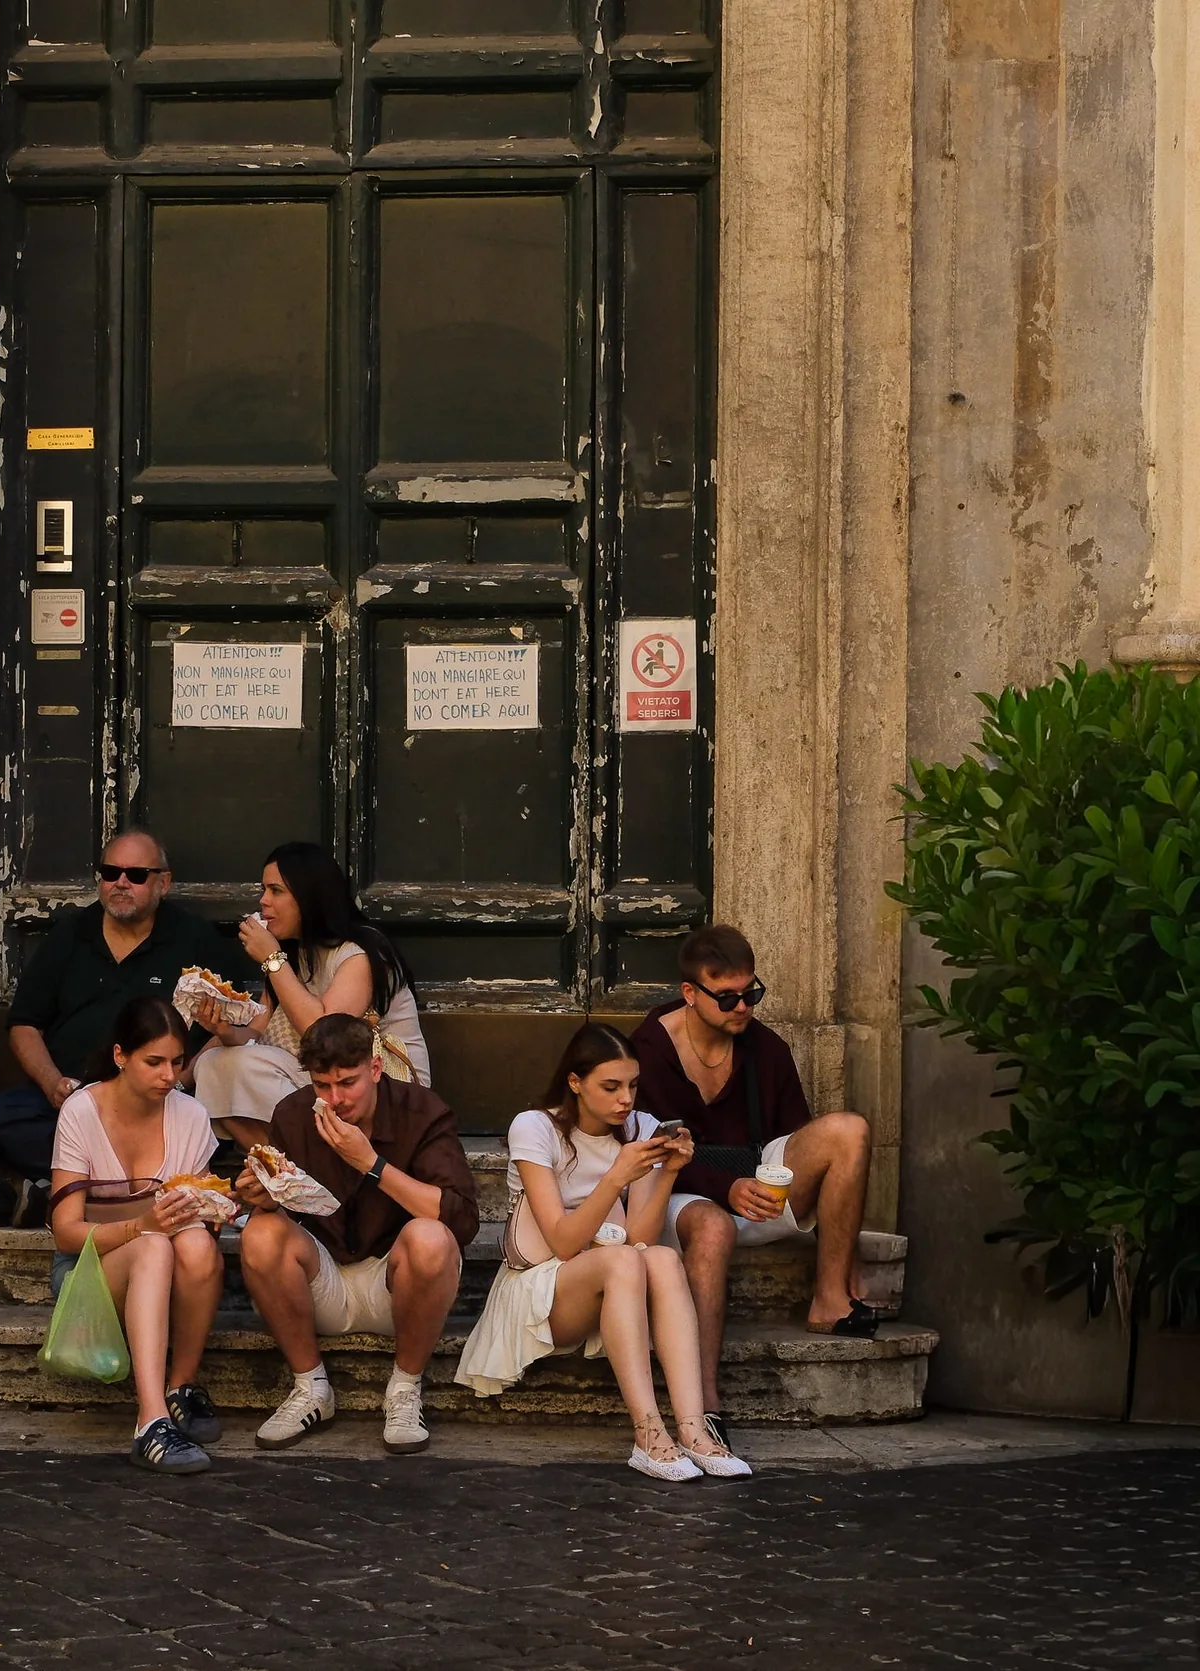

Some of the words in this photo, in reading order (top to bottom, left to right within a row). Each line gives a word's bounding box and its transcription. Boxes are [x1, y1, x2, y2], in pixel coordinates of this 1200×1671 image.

[175, 665, 200, 680] NON
[211, 666, 265, 681] MANGIARE
[269, 667, 291, 679] QUI
[412, 670, 437, 685] NON
[443, 668, 501, 683] MANGIARE
[502, 668, 526, 681] QUI
[216, 684, 238, 697] EAT
[247, 683, 281, 697] HERE
[457, 687, 478, 700] EAT
[485, 686, 520, 699] HERE
[638, 697, 680, 706] VIETATO
[176, 704, 193, 720] NO
[200, 704, 249, 720] COMER
[257, 705, 288, 720] AQUI
[413, 704, 432, 721] NO
[440, 702, 491, 720] COMER
[498, 704, 530, 718] AQUI
[638, 709, 680, 718] SEDERSI
